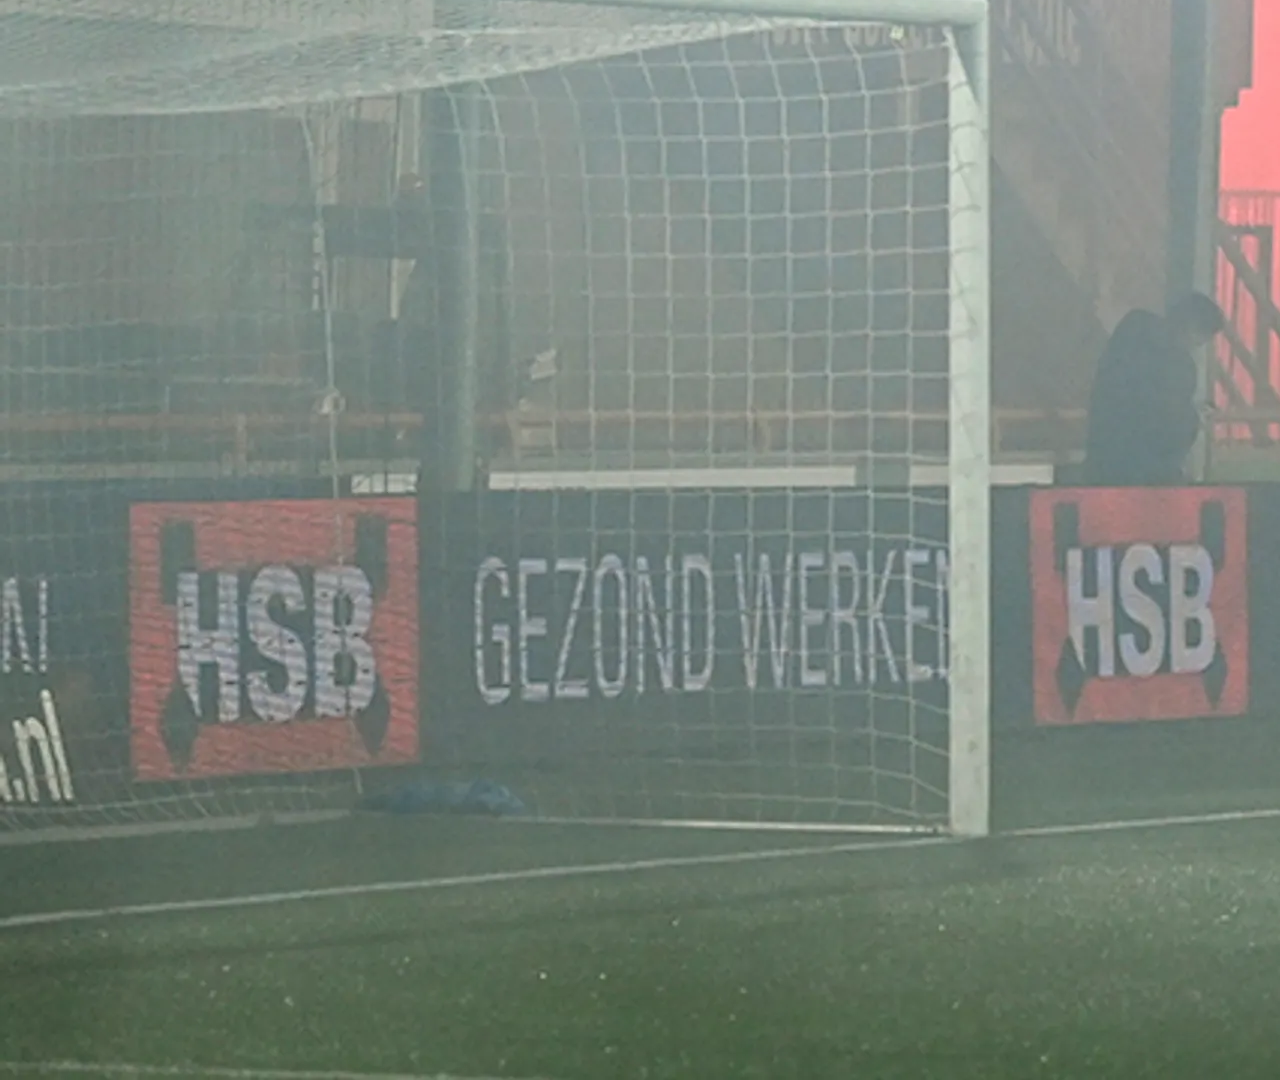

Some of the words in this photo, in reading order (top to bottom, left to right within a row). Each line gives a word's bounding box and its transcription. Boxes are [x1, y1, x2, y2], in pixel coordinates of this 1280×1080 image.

[177, 565, 376, 723] HSB
[473, 554, 715, 704] GEZOND
[1066, 544, 1217, 678] HSB
